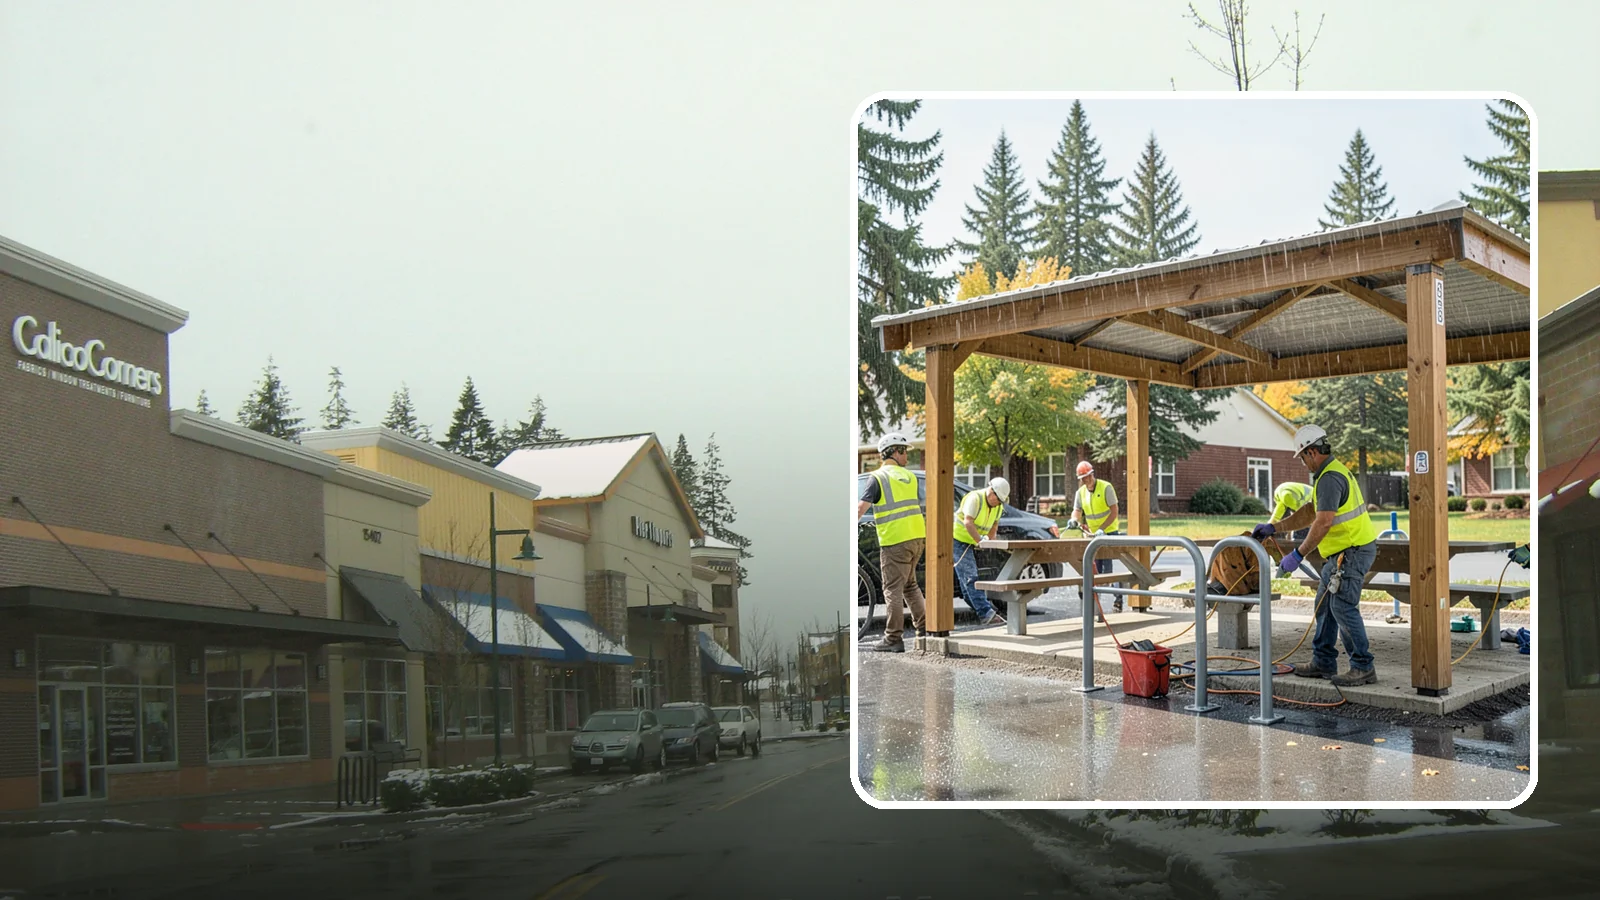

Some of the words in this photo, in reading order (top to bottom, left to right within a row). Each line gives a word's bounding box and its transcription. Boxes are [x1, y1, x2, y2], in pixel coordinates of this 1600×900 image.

[17, 360, 47, 377] FABRICS
[51, 370, 78, 387] WINDOW
[78, 379, 117, 399] TREATMENTS
